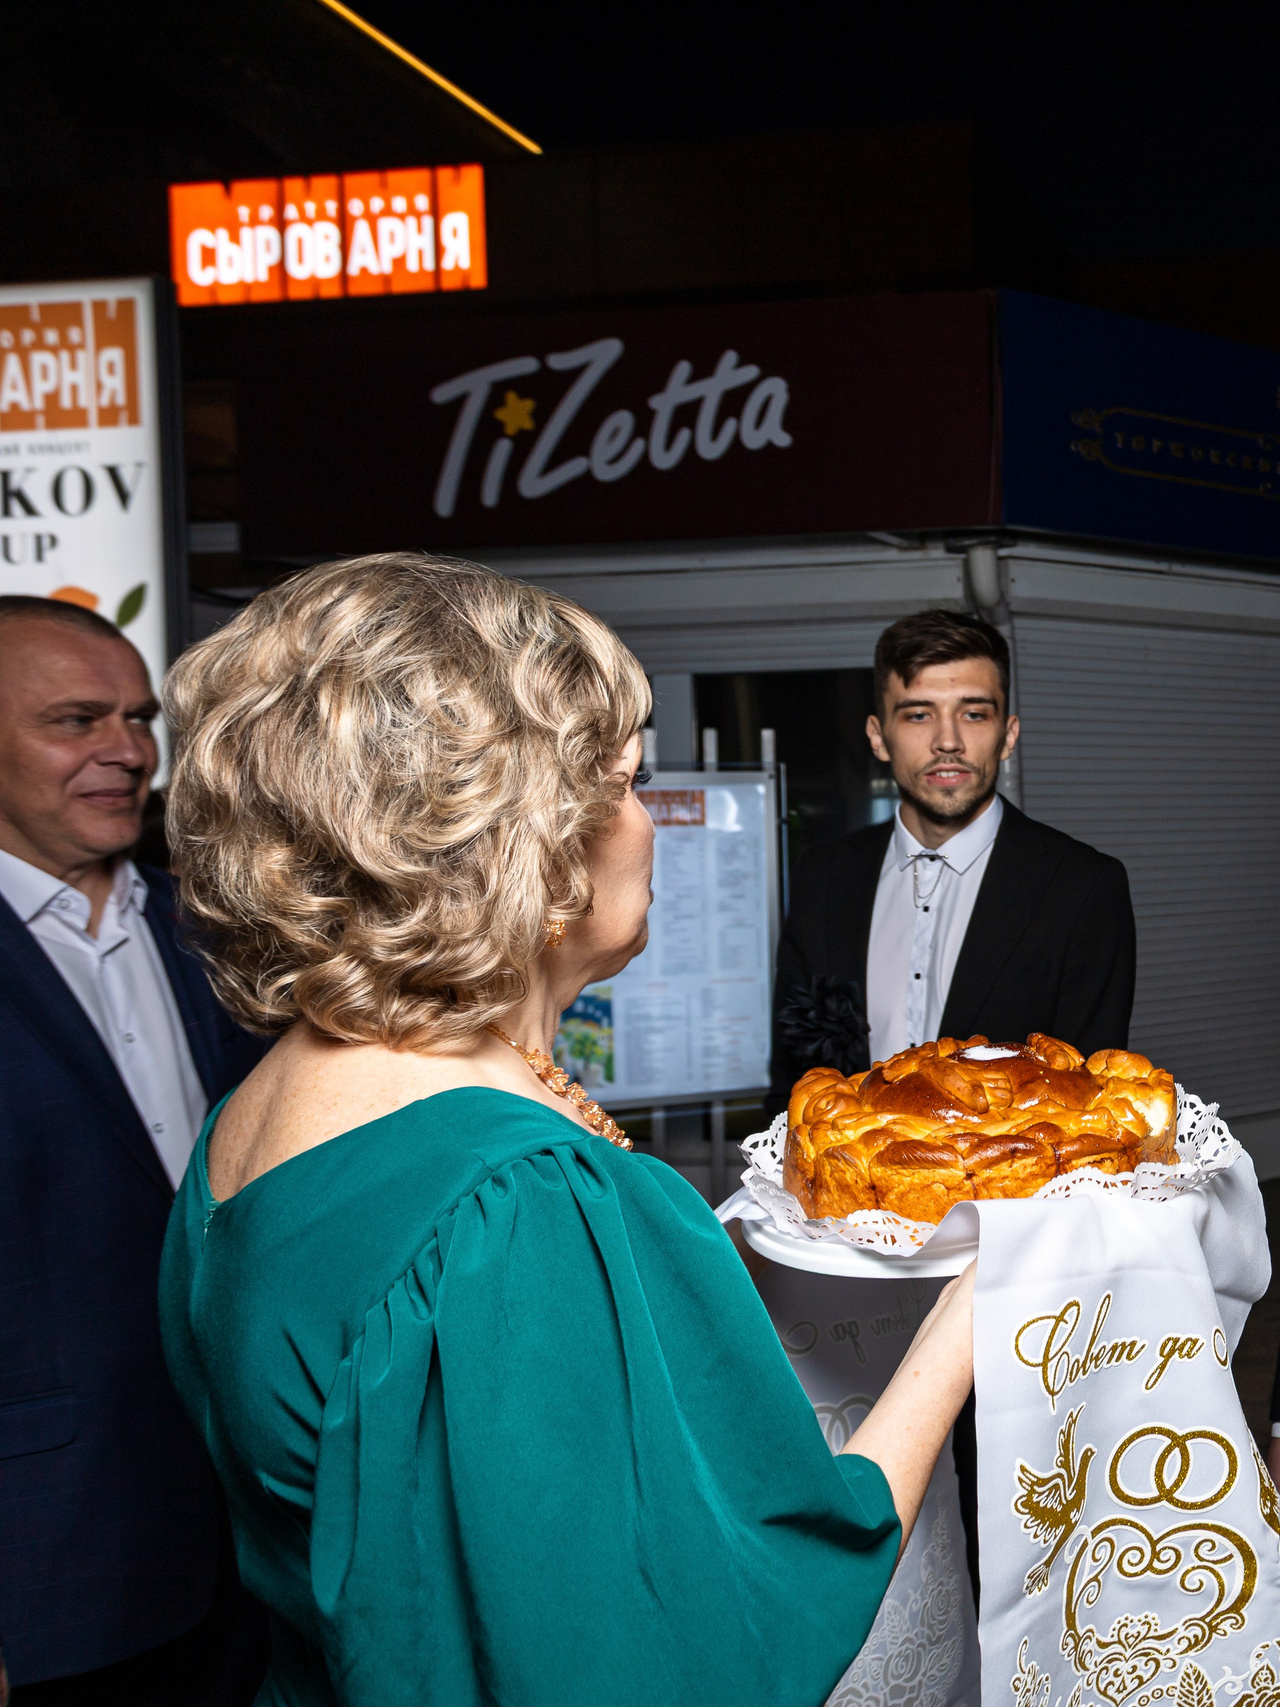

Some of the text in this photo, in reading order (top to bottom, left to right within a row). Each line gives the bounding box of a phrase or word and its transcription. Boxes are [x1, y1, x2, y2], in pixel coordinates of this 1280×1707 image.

[237, 193, 430, 222] ТРАТТОРИЯ
[186, 212, 471, 287] СЫРОВАРНЯ
[430, 337, 793, 518] TiZetta
[0, 462, 146, 518] KOV
[0, 532, 59, 565] UP
